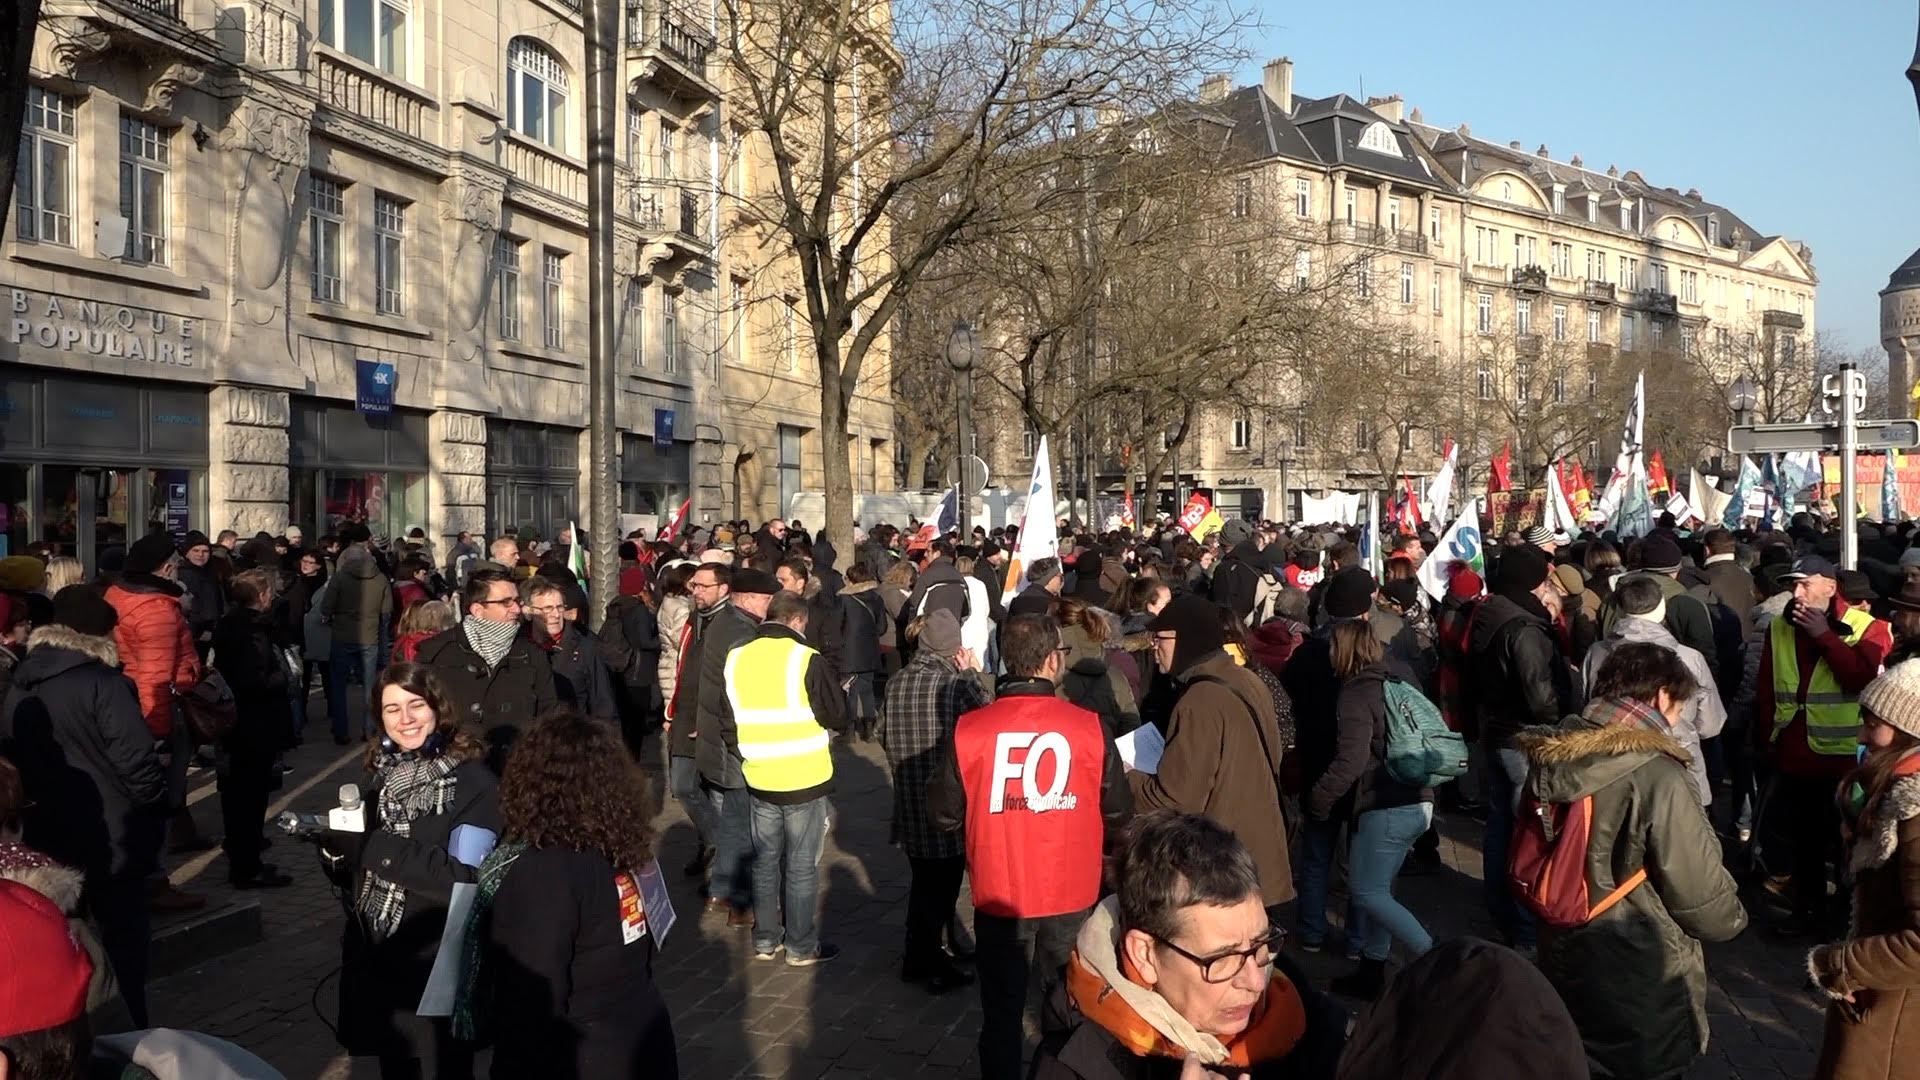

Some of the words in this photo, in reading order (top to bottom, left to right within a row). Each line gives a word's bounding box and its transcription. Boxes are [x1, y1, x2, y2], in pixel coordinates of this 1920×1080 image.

[10, 288, 192, 338] BANQUE
[10, 318, 192, 366] POPULAIRE
[990, 731, 1072, 814] FO
